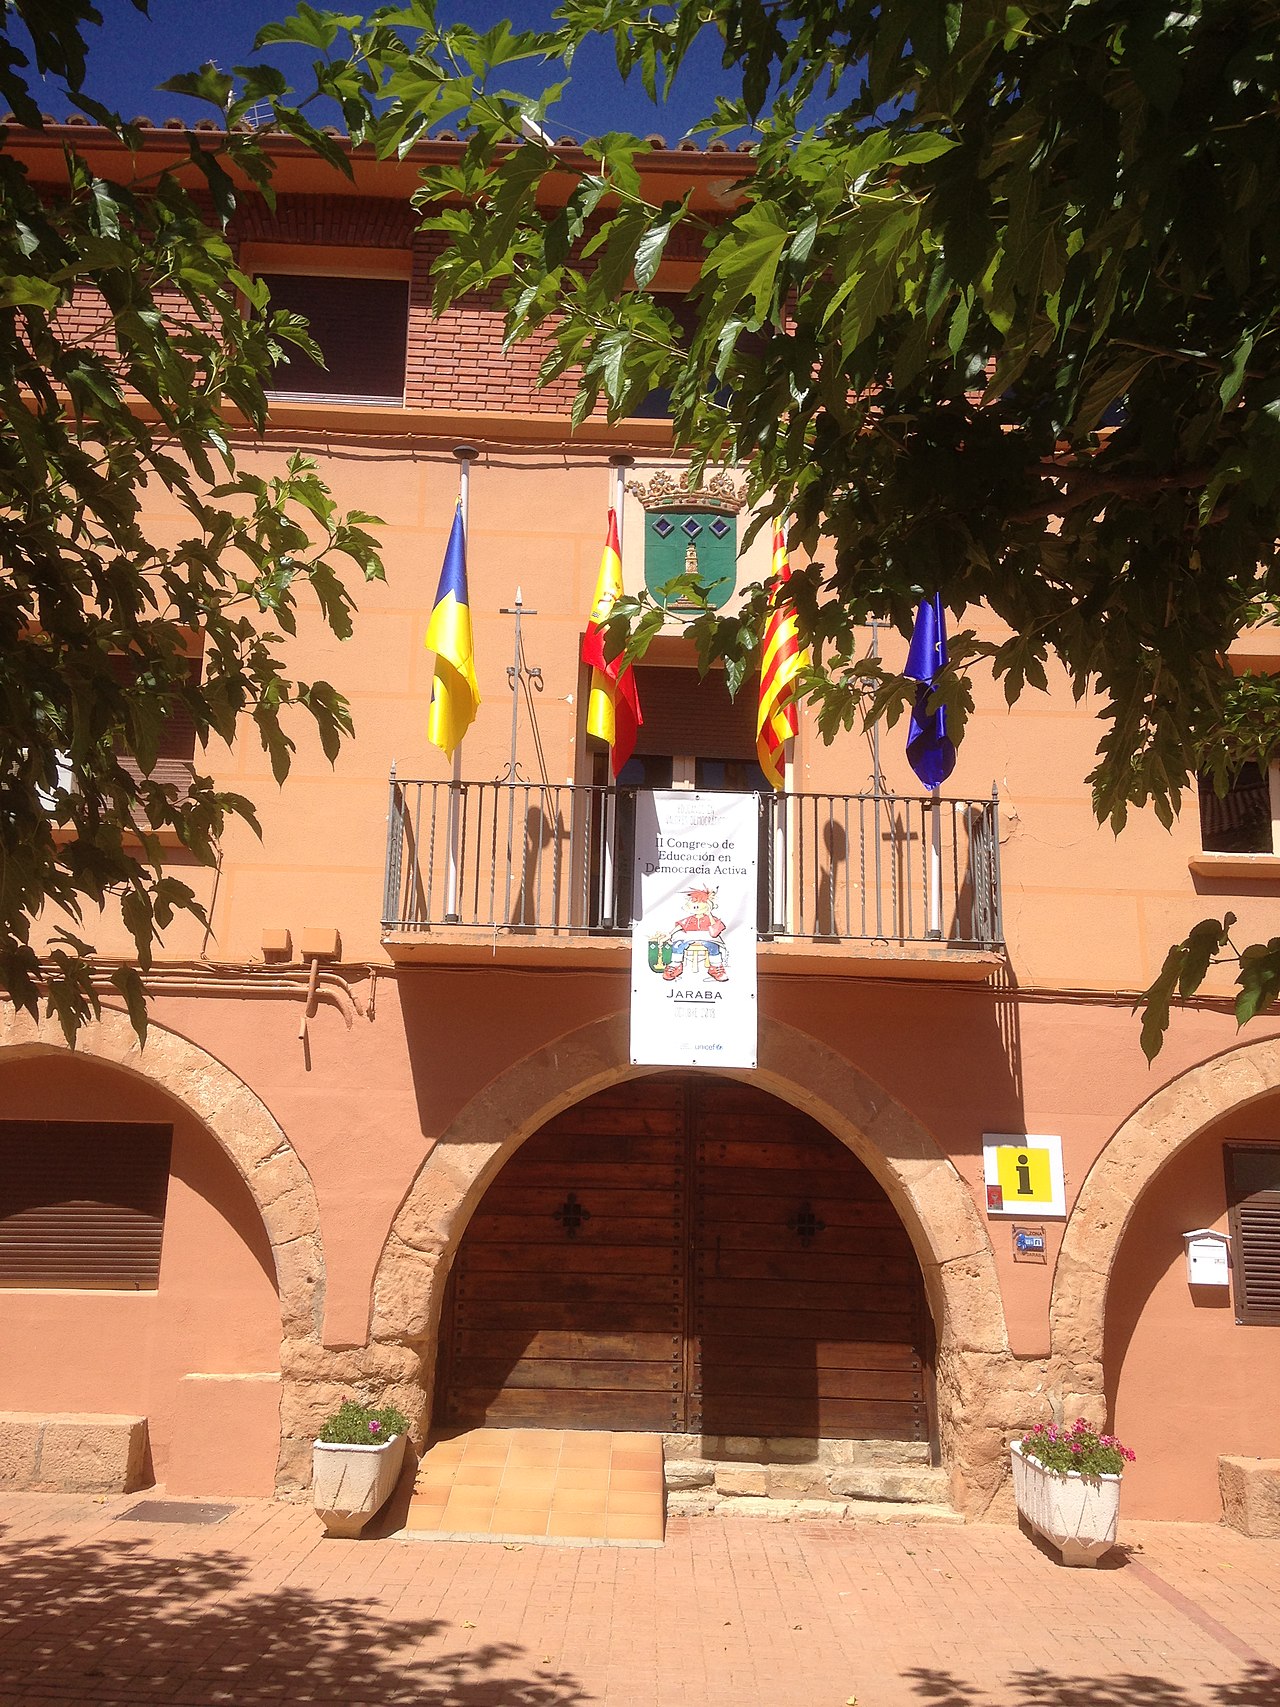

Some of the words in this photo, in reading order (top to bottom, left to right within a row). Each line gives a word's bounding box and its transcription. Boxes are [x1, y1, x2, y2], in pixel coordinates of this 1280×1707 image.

[655, 837, 664, 848] II
[666, 837, 719, 850] Congreso
[721, 839, 735, 850] de
[658, 850, 715, 862] Educación
[718, 854, 731, 862] en
[645, 862, 711, 875] Democracia
[713, 865, 747, 875] Activa
[666, 989, 723, 1000] JARABA
